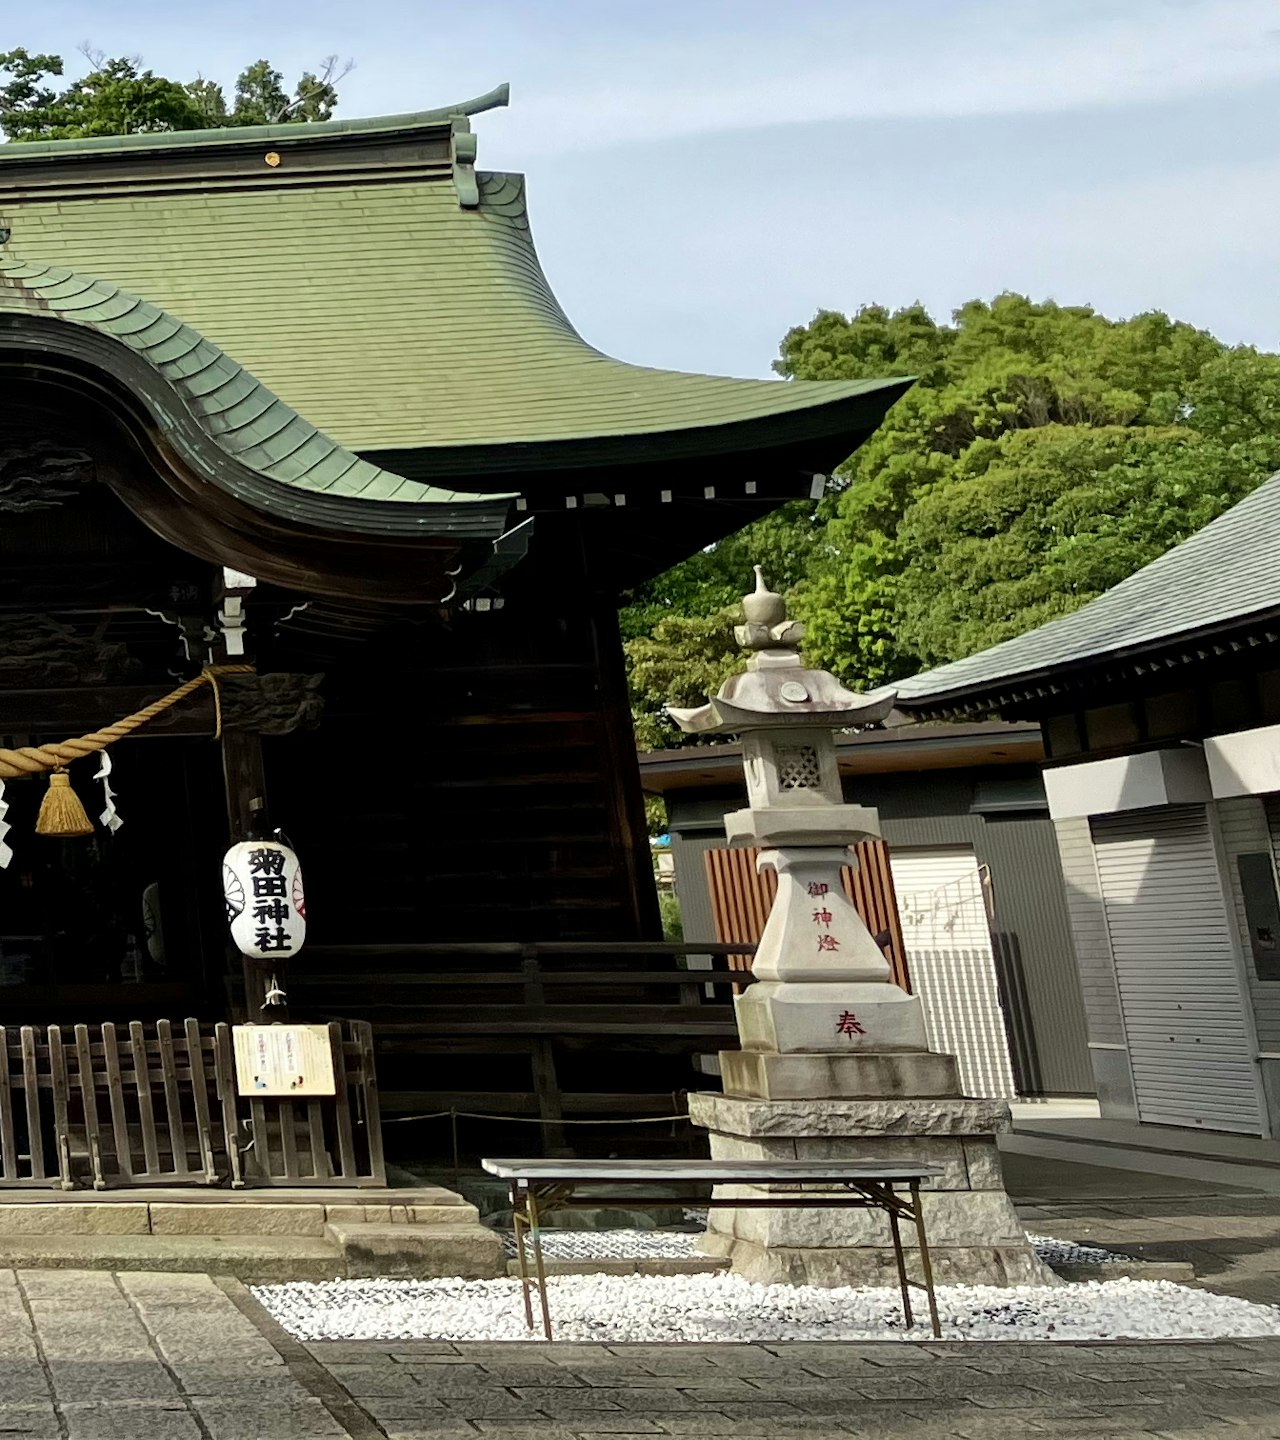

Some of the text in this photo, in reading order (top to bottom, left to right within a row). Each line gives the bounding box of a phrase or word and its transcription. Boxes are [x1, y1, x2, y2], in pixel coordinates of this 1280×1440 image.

[248, 848, 293, 953] 菊田神社
[807, 882, 841, 952] 御神燈
[836, 1010, 867, 1040] 奉
